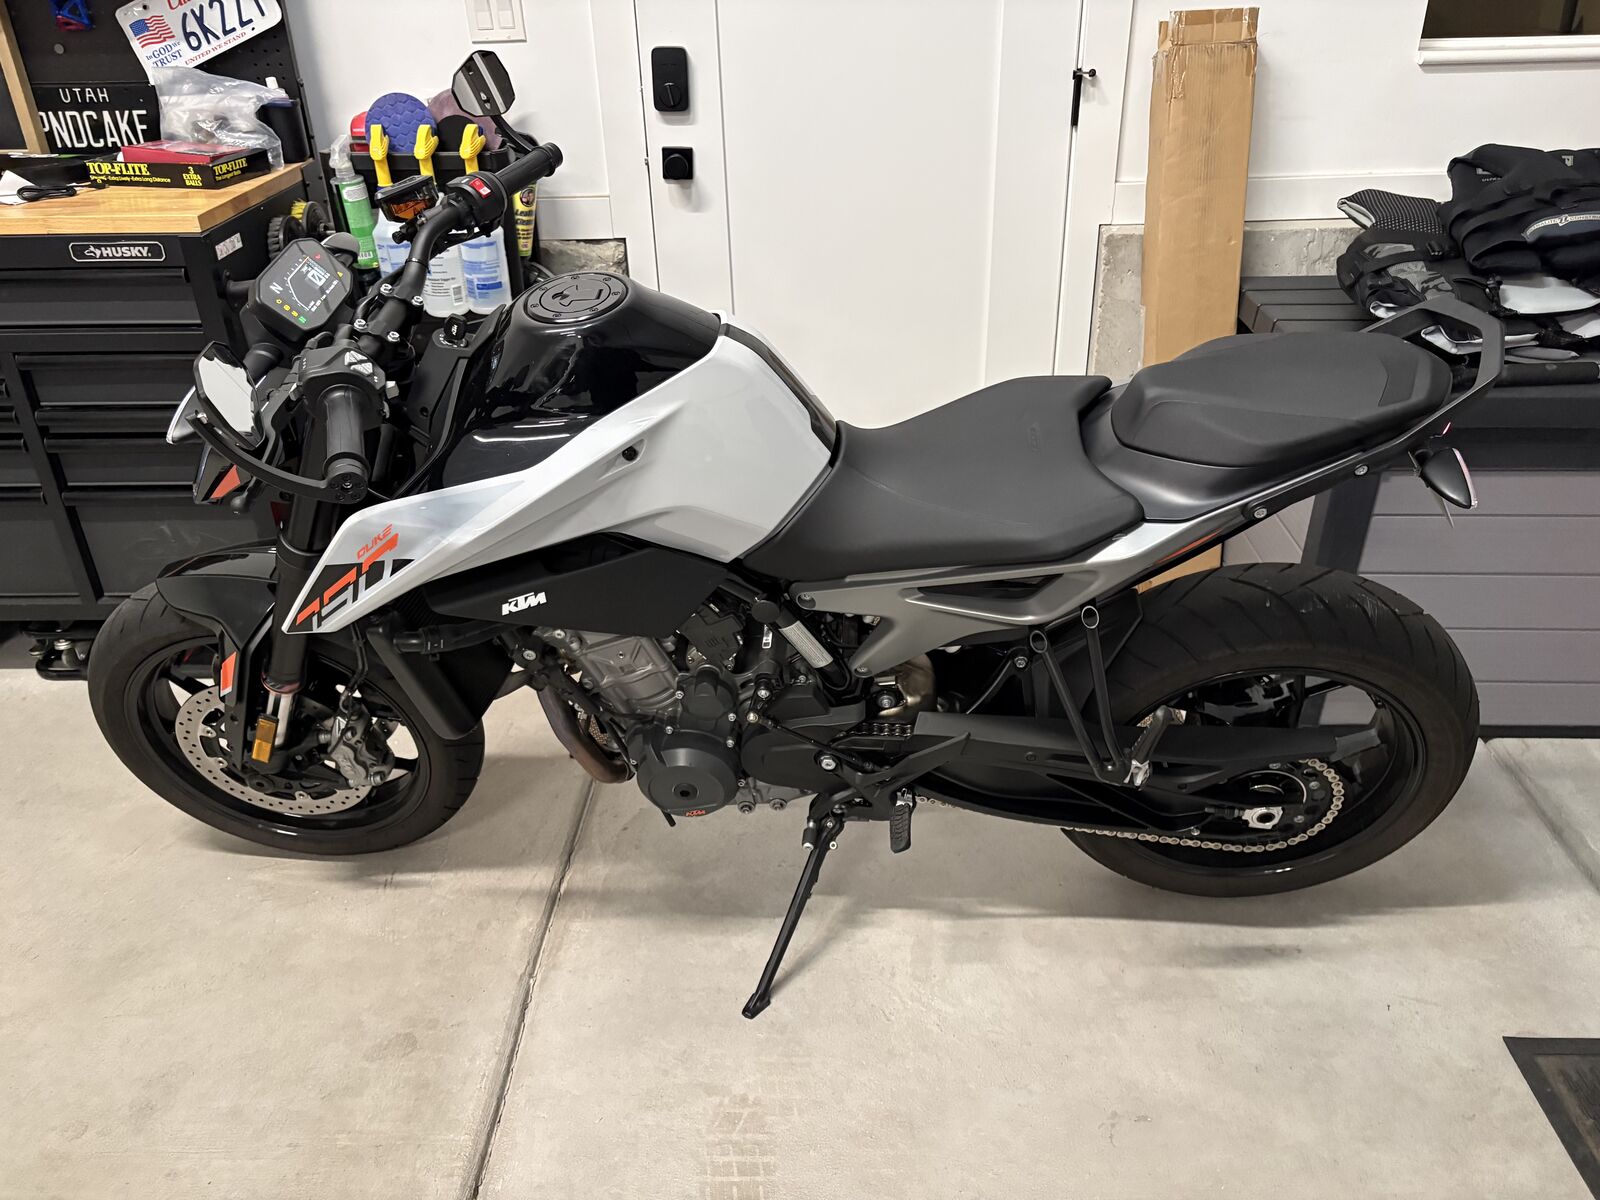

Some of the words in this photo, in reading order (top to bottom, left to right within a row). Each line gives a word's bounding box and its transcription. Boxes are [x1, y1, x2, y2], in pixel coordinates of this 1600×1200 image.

[152, 43, 173, 61] GOD
[185, 48, 212, 66] UNITED
[211, 42, 224, 53] WE
[223, 31, 247, 47] STAND
[152, 48, 183, 68] TRUST
[59, 88, 109, 103] UTAH
[86, 162, 150, 176] TOP-FLITE
[187, 166, 194, 174] 3
[212, 158, 248, 176] TOP-FLITE
[182, 173, 202, 181] EXTRA
[185, 179, 203, 187] BALLS
[102, 246, 148, 257] HUSKY
[269, 282, 283, 295] N
[357, 523, 393, 560] DUKE
[296, 532, 399, 632] 790
[502, 591, 547, 616] KTM
